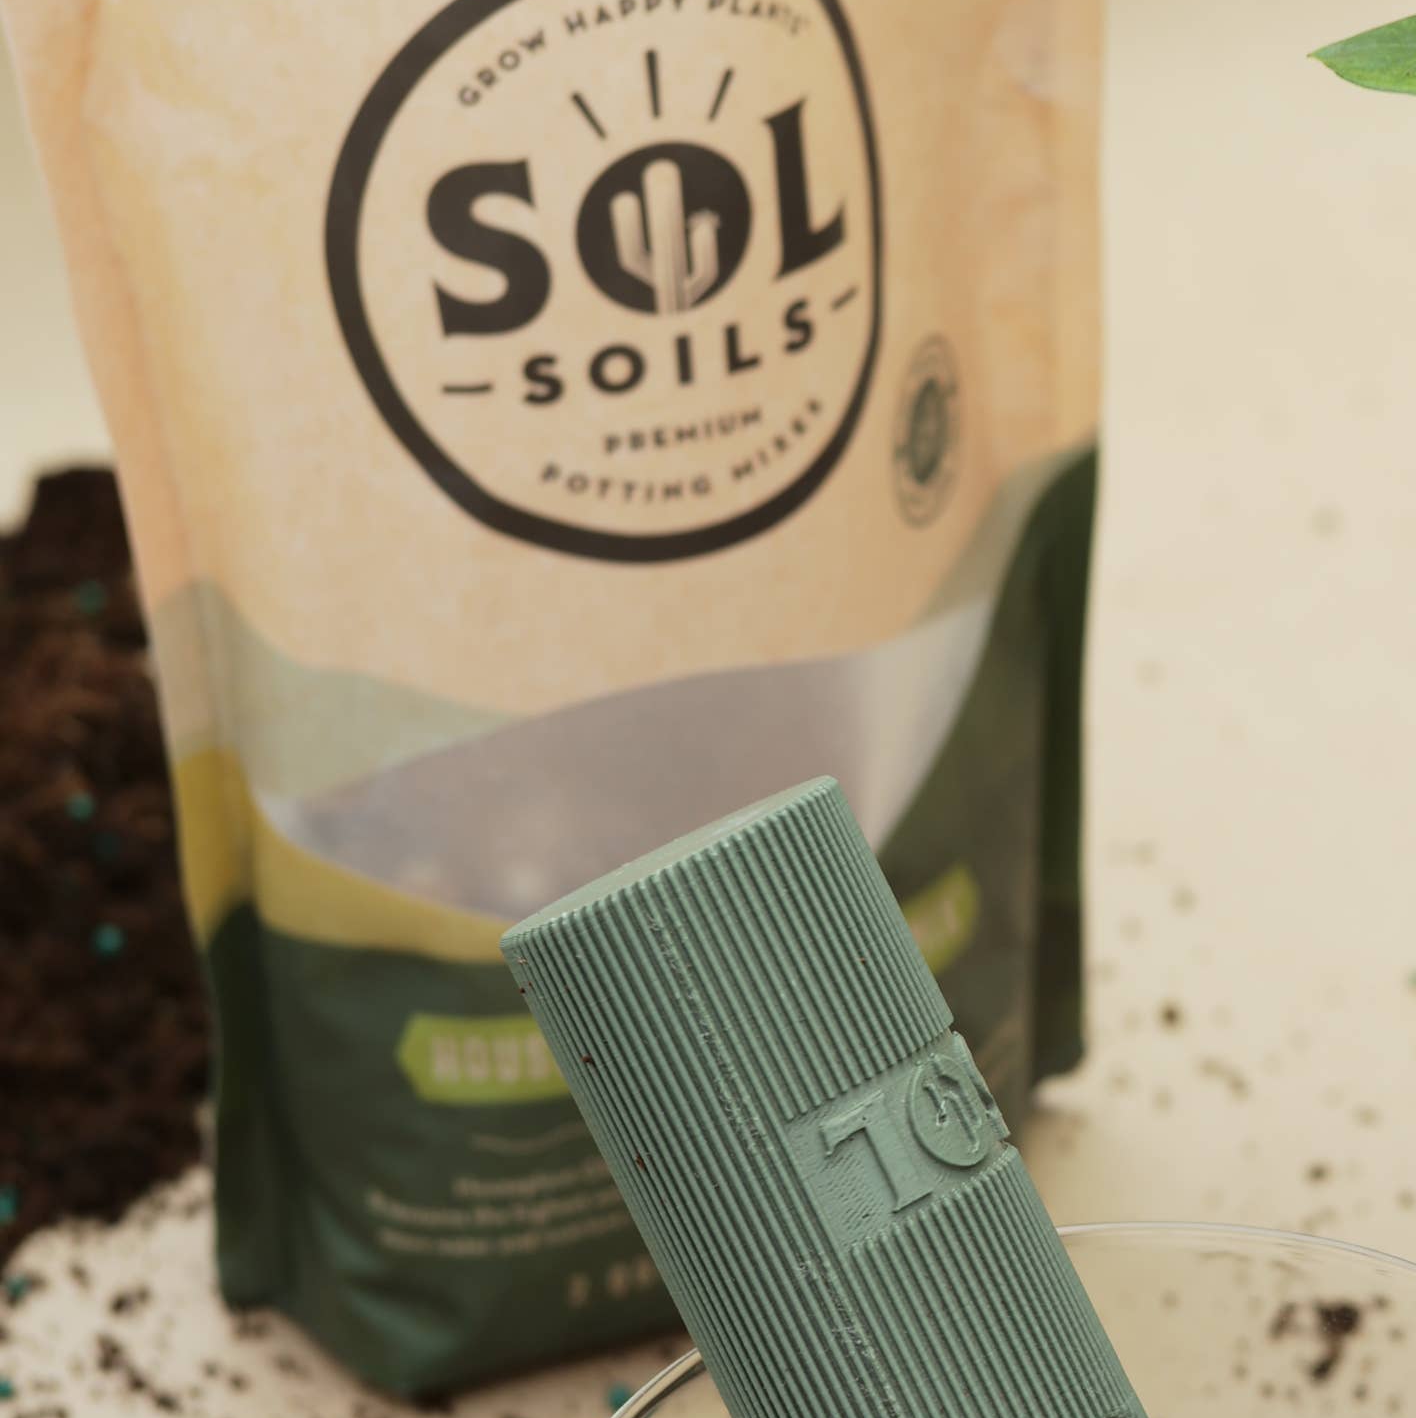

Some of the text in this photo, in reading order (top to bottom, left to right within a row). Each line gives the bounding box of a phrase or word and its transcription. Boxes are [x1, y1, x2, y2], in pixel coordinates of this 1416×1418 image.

[458, 30, 547, 107] GROW
[425, 95, 848, 339] SOL
[522, 298, 816, 406] SOILS
[604, 406, 762, 454] PREMIUM
[540, 461, 713, 504] POTTING
